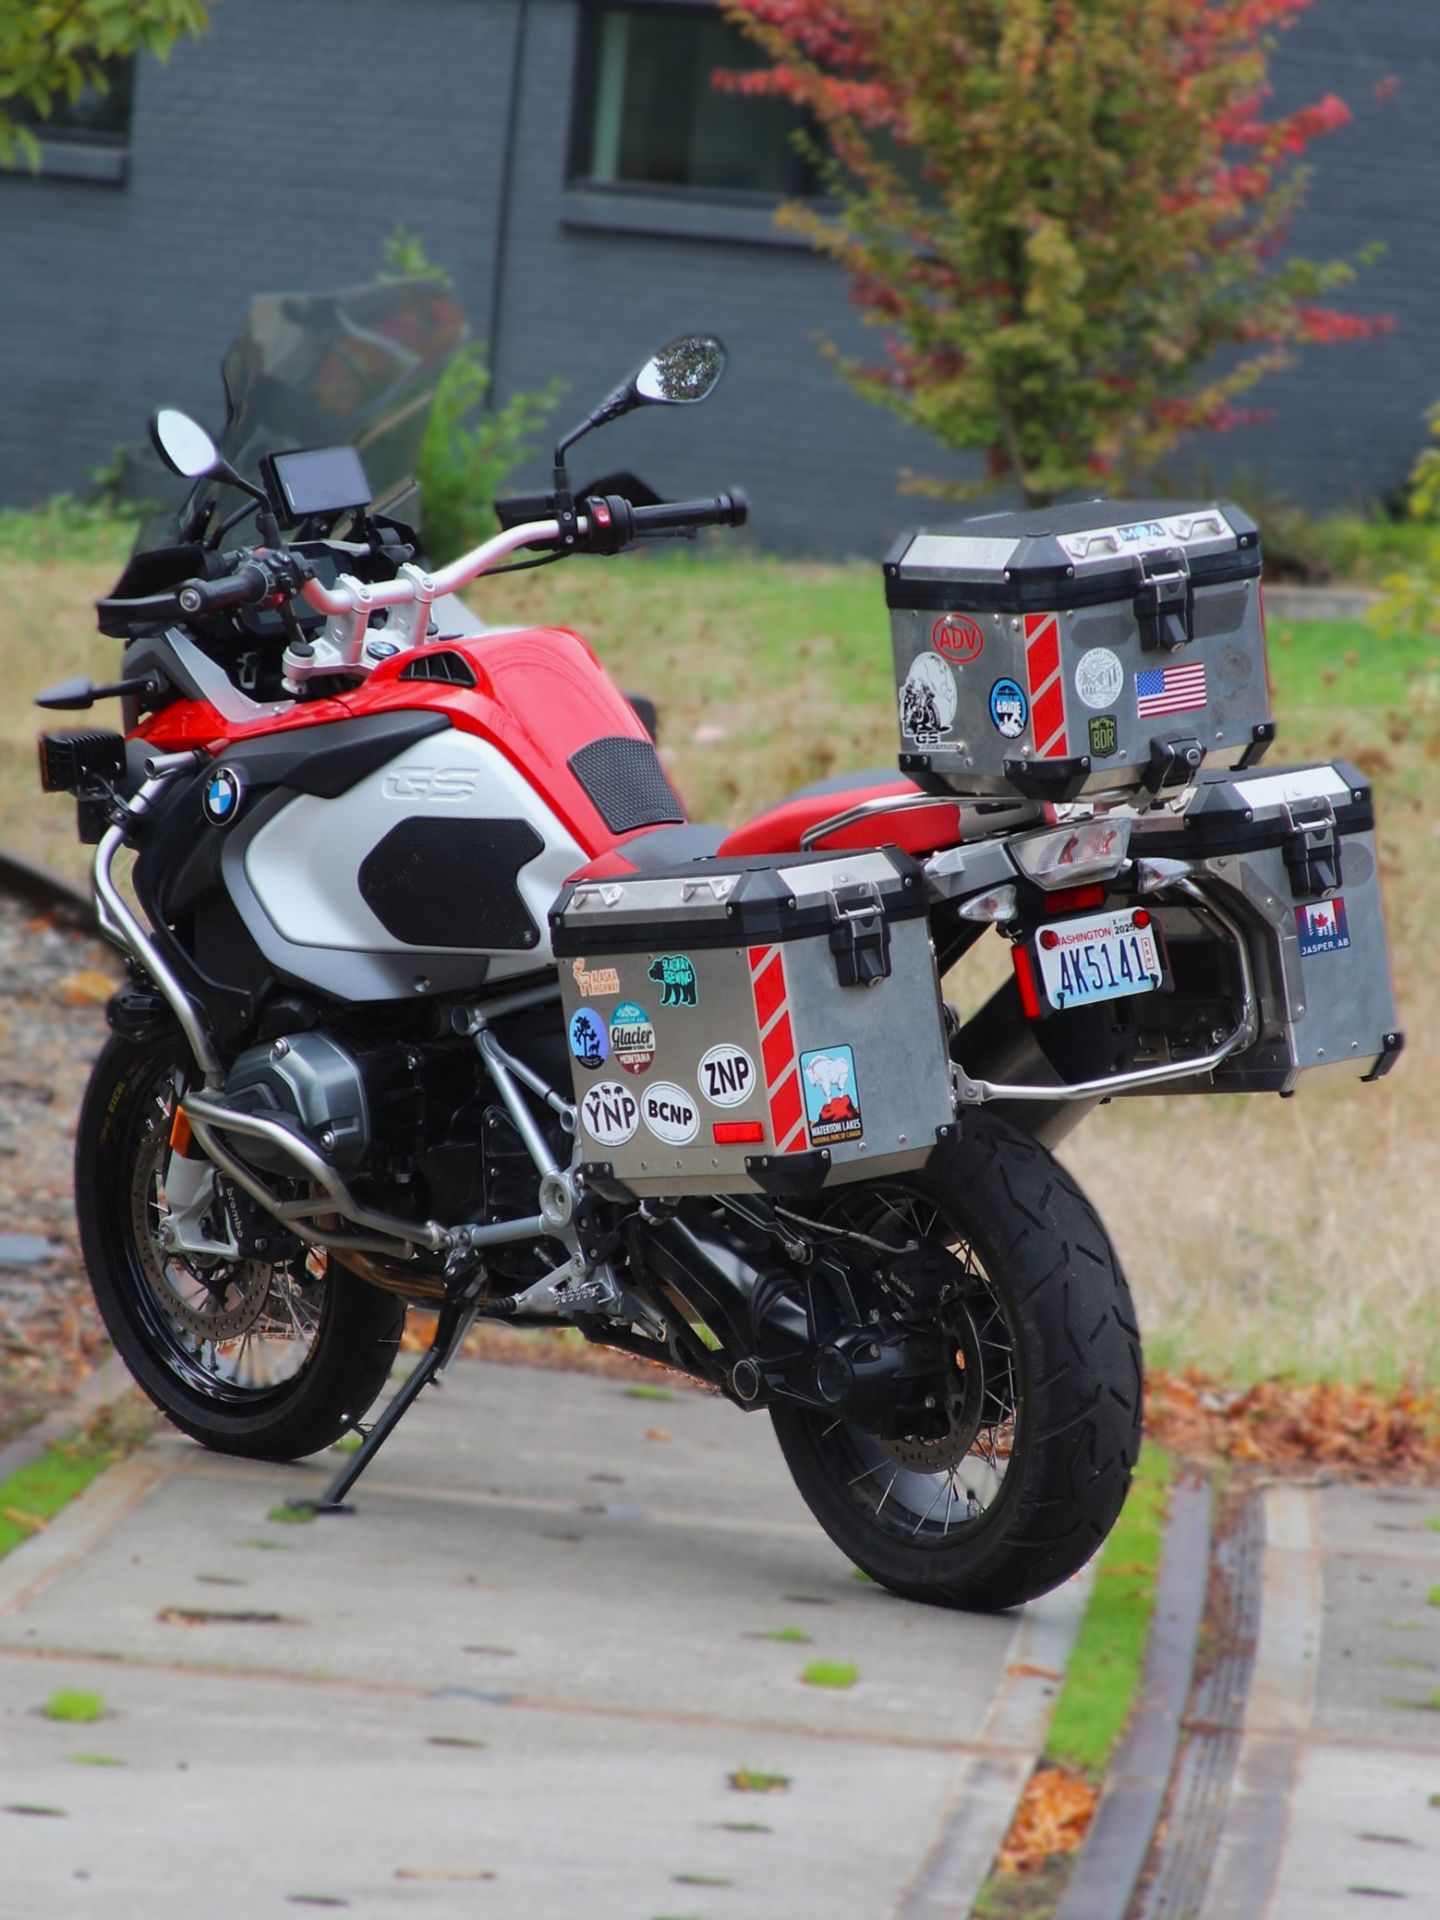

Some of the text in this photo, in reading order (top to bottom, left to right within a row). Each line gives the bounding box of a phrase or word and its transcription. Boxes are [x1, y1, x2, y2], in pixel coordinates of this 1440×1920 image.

[940, 627, 977, 650] ADV
[916, 731, 939, 744] GS
[1093, 728, 1114, 749] BDR
[382, 766, 480, 801] GS
[1114, 922, 1136, 935] 2025
[1337, 937, 1349, 947] AB
[591, 969, 617, 982] ALASKA
[1060, 936, 1149, 995] 4K5141
[612, 1026, 652, 1049] Glacier
[619, 1053, 651, 1065] MONTANA
[704, 1056, 749, 1096] ZNP
[585, 1098, 635, 1133] YNP
[648, 1099, 693, 1125] BCNP
[811, 1118, 861, 1136] WATERTON LAKES
[226, 1186, 243, 1239] brembo
[890, 1271, 915, 1297] brembo
